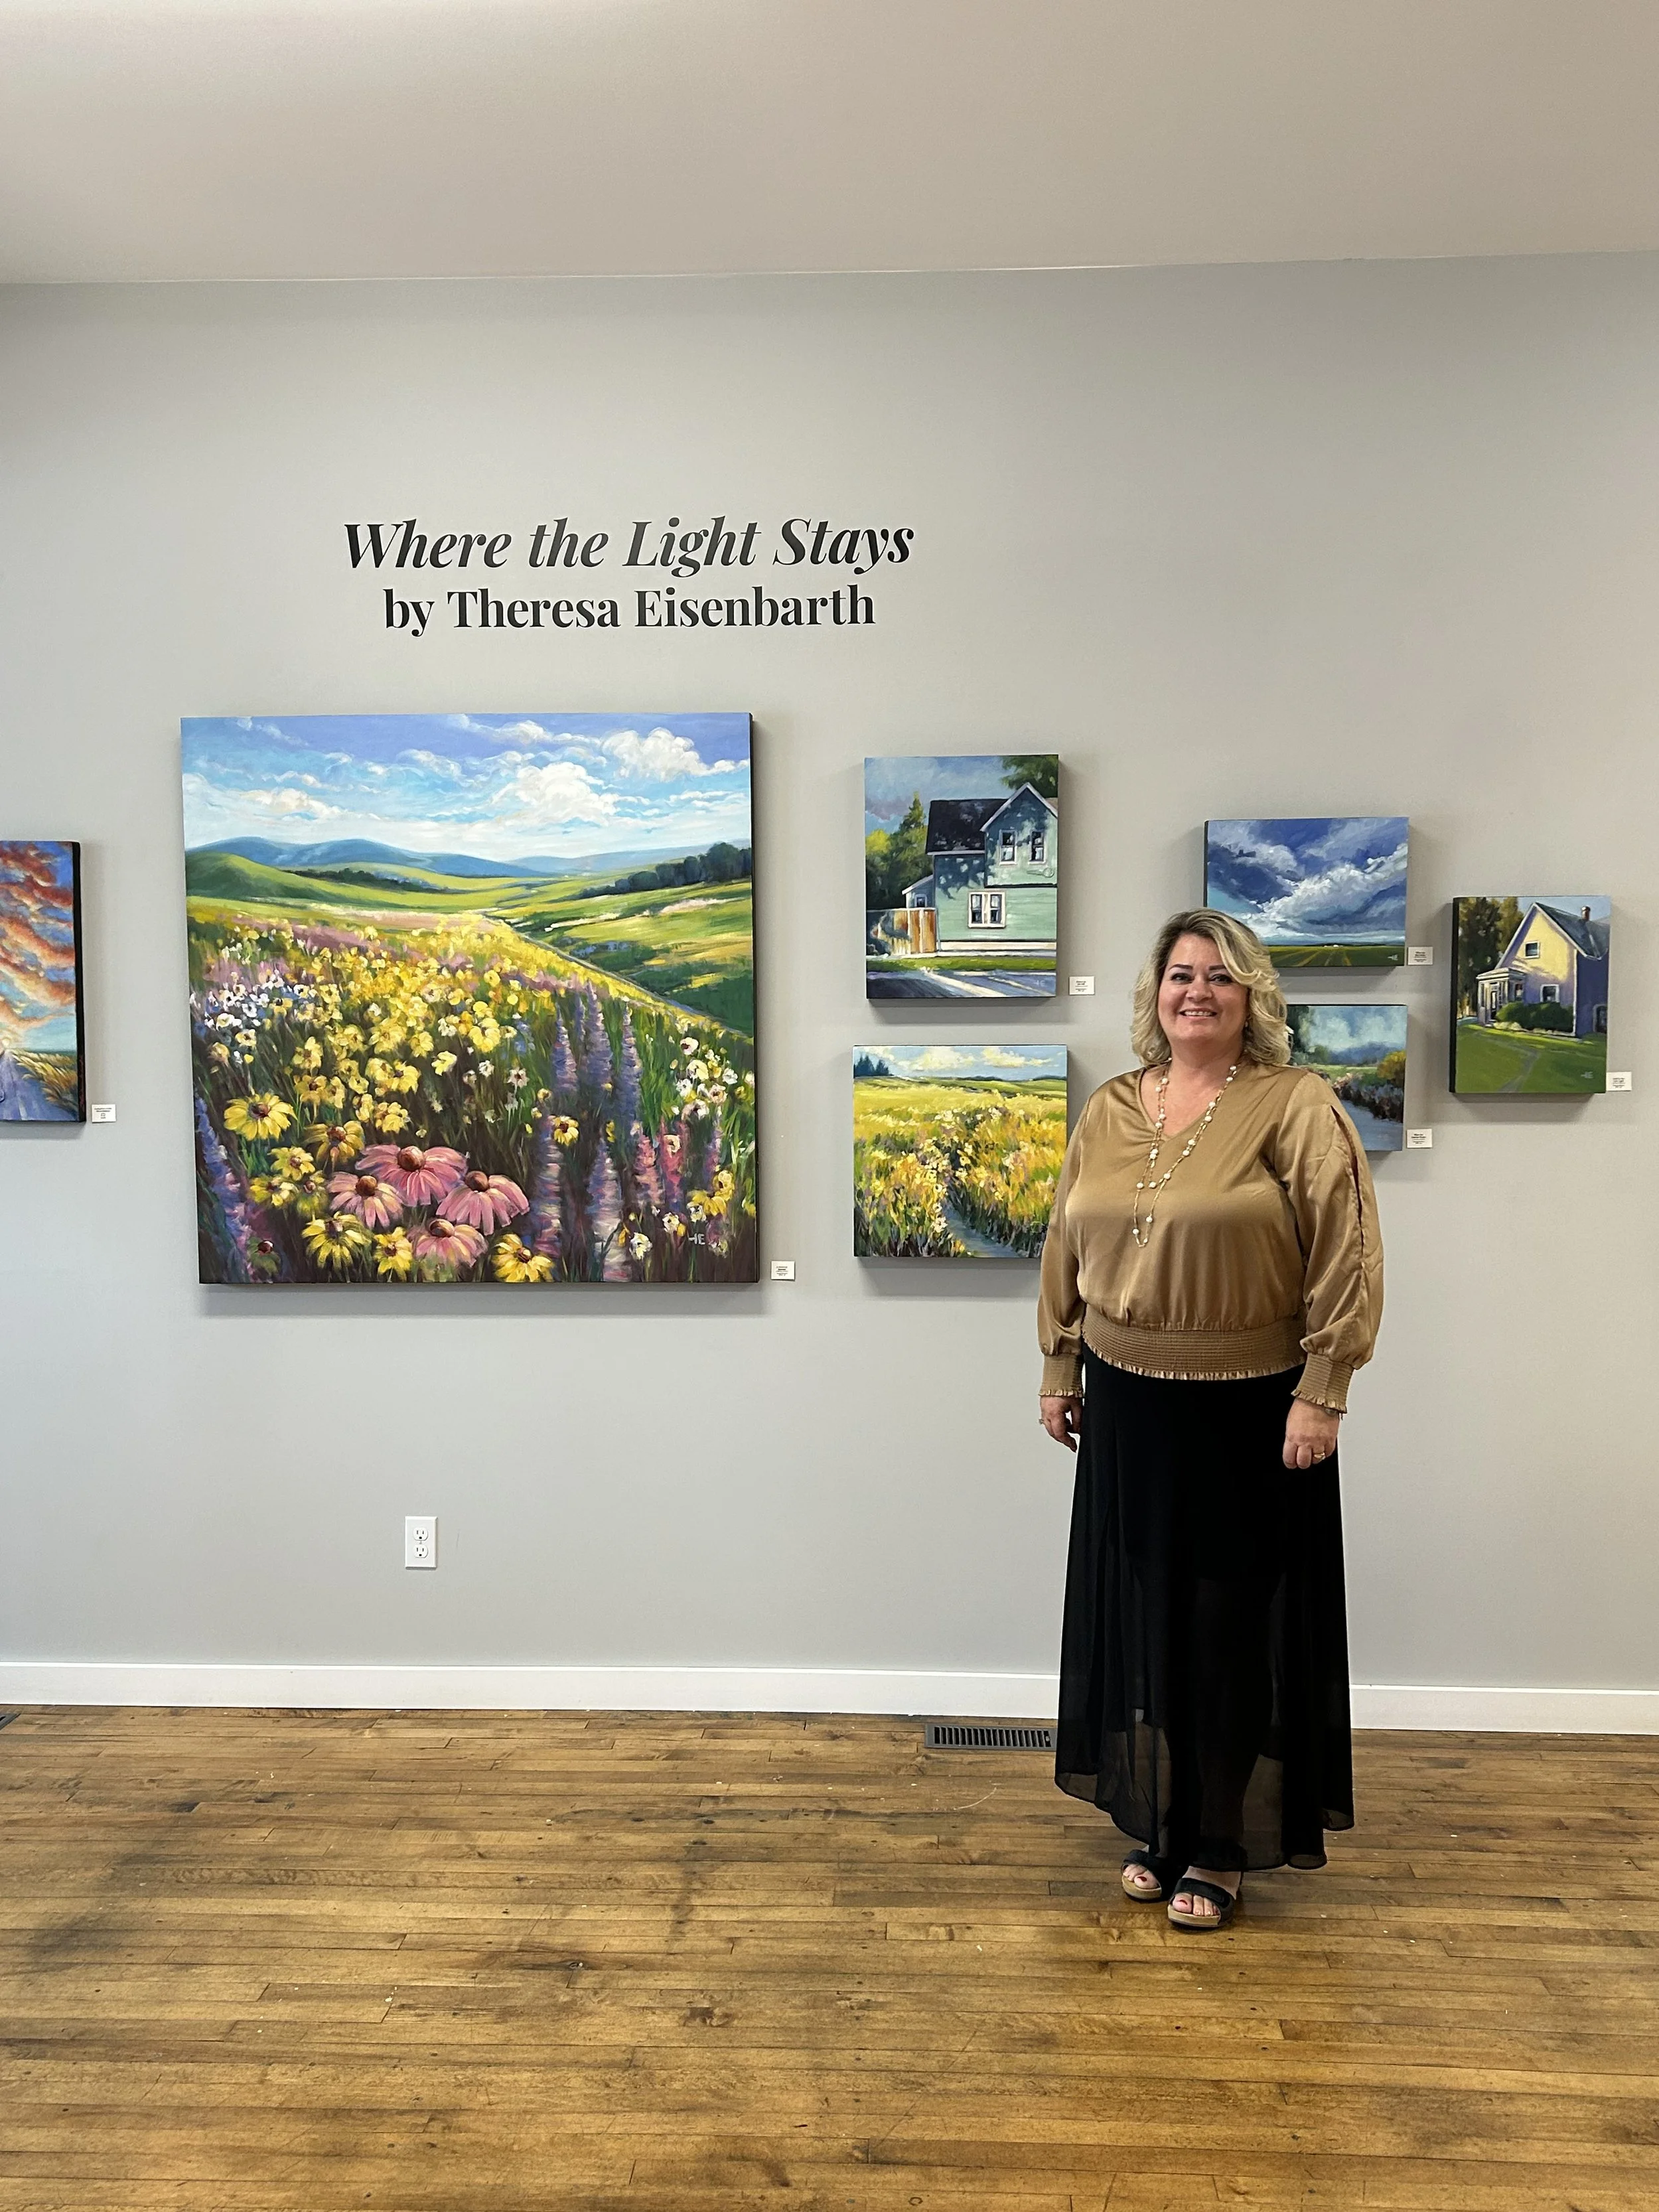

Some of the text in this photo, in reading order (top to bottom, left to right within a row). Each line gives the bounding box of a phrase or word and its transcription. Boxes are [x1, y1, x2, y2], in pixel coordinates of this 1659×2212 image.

[344, 516, 914, 578] Where the Light Stays
[382, 584, 876, 637] by Theresa Eisenbarth
